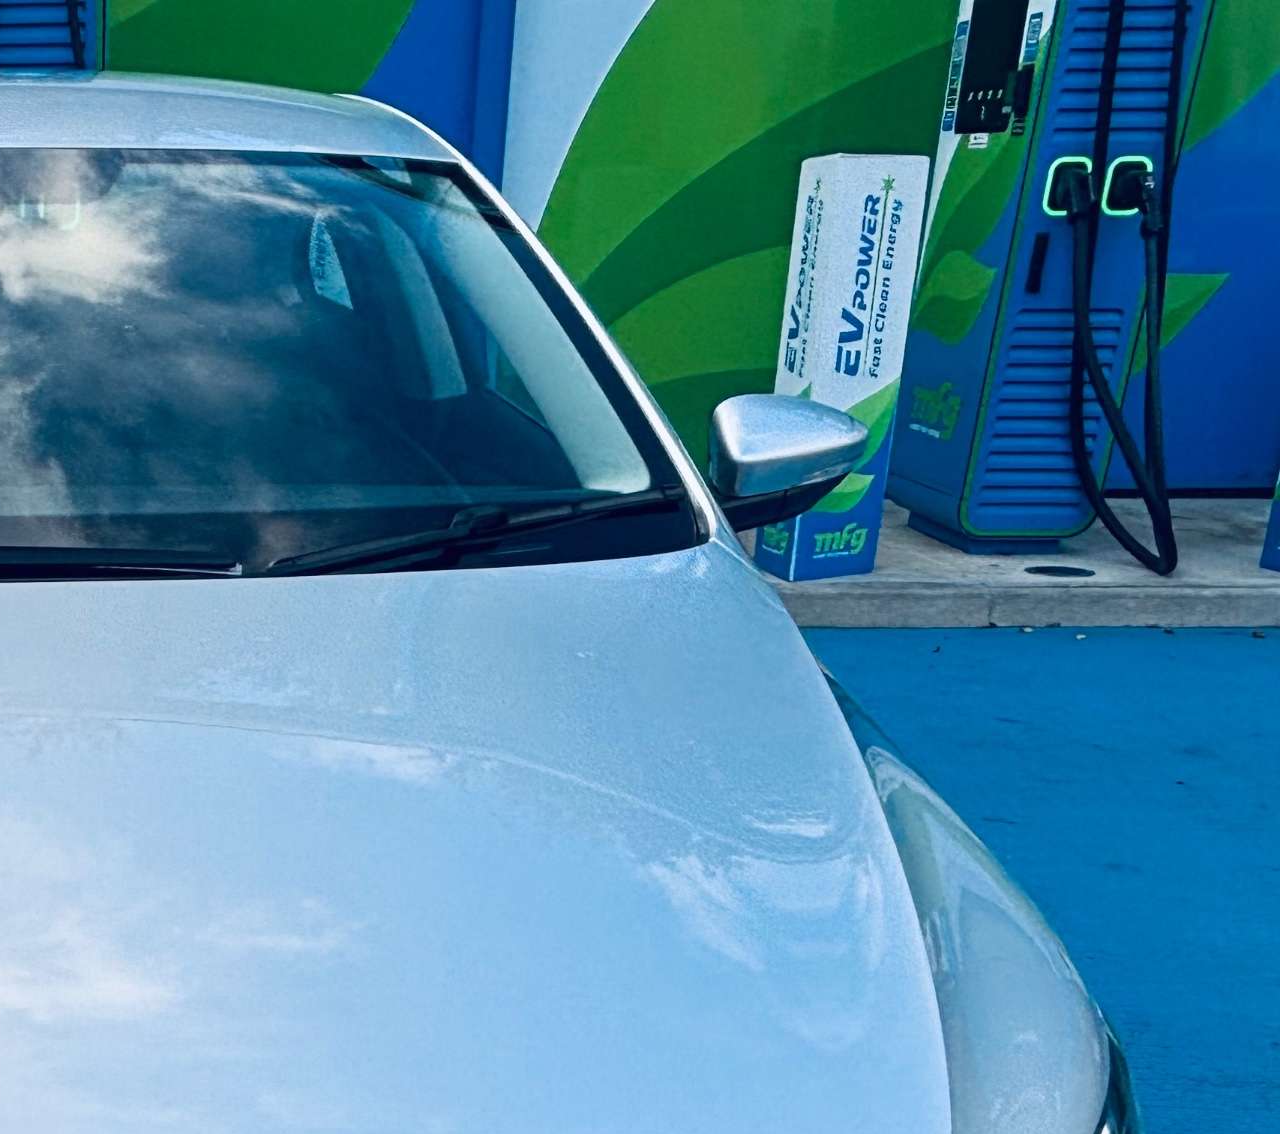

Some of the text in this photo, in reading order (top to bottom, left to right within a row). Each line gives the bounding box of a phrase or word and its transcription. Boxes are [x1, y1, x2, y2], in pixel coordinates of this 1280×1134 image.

[869, 198, 904, 379] Fast Clean Energy
[813, 522, 868, 555] mfg
